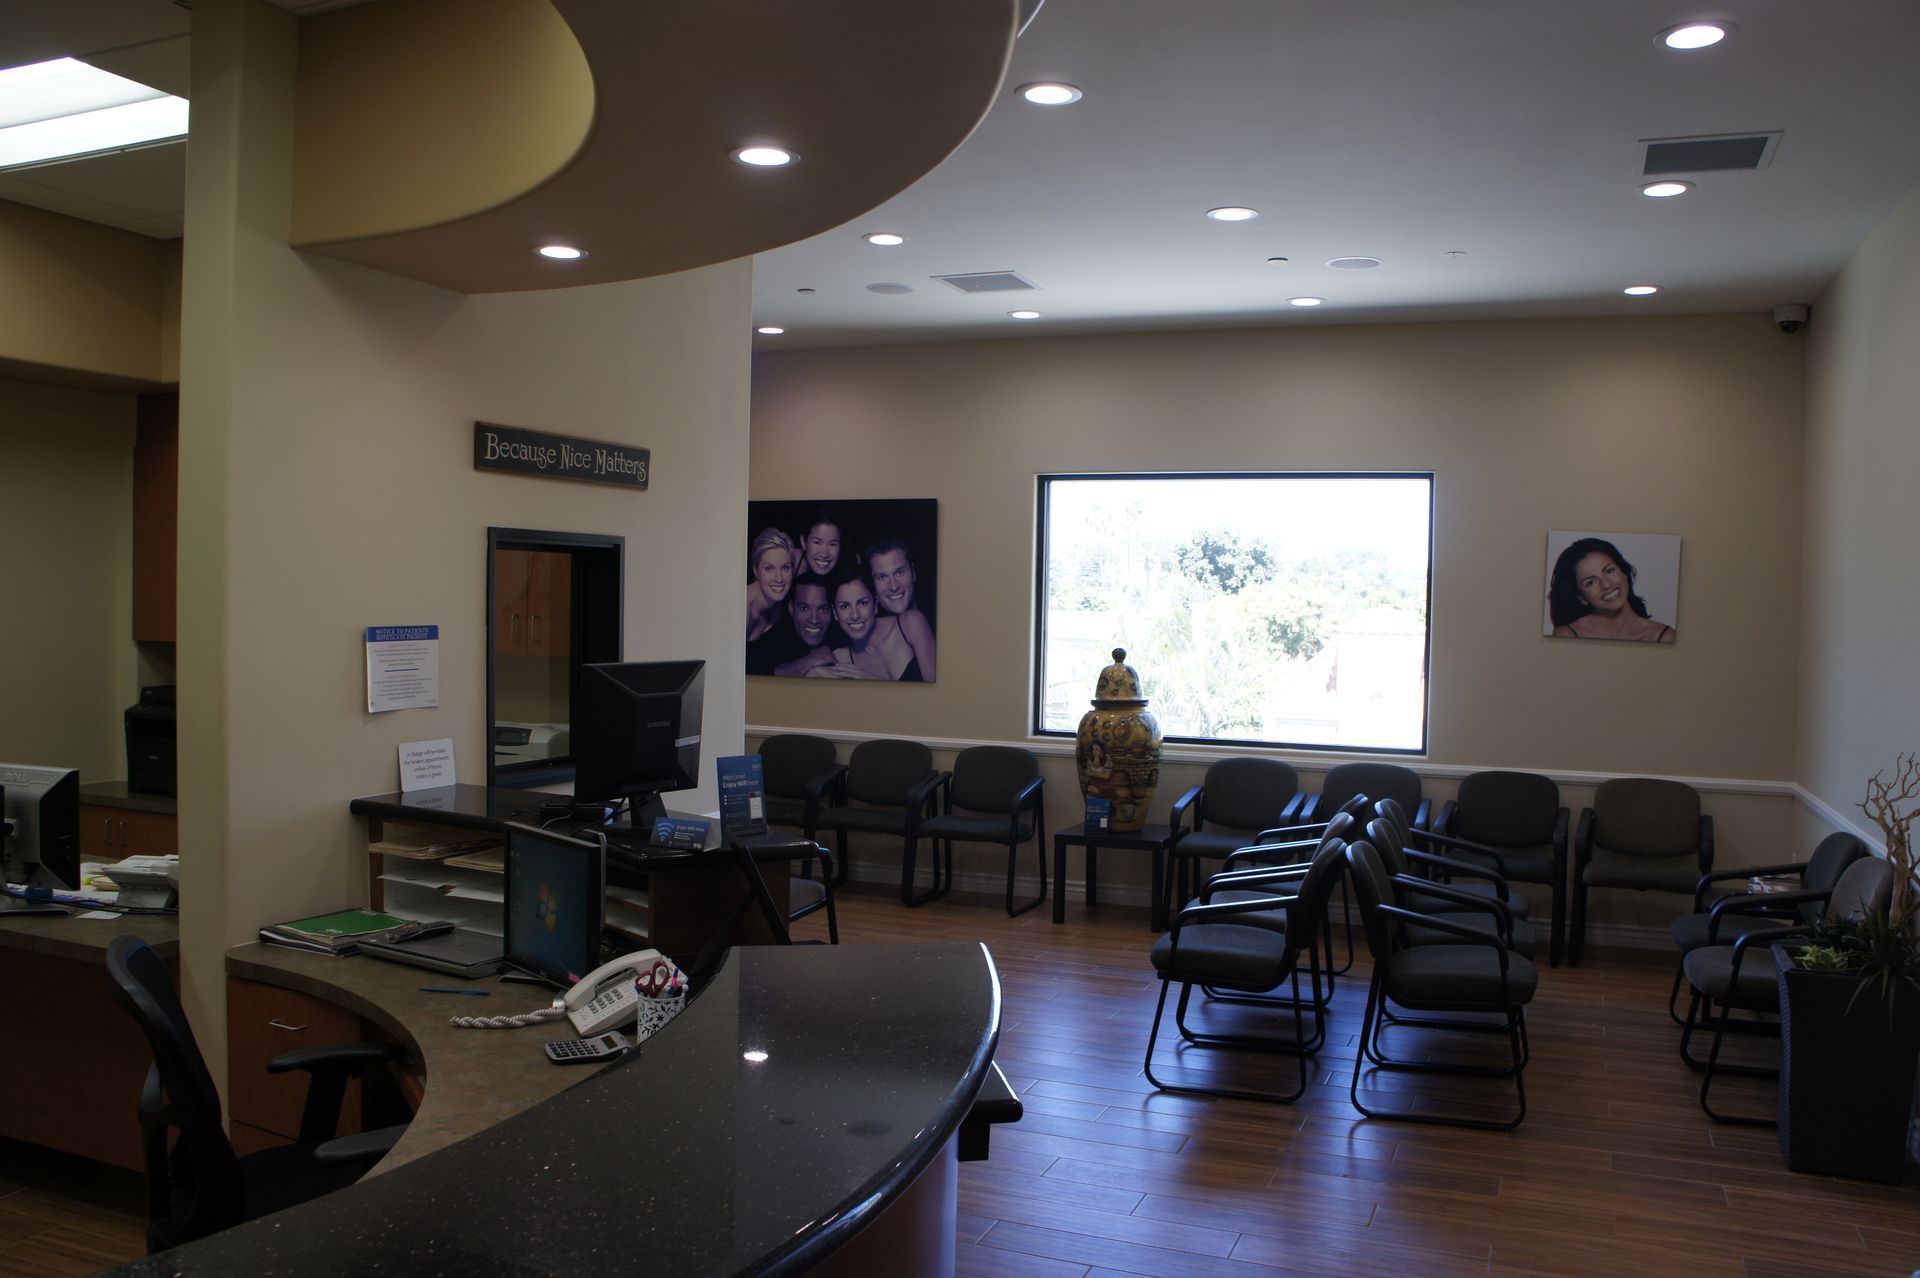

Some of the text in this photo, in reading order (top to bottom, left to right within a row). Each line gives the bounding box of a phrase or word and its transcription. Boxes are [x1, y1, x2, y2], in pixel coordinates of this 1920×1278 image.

[484, 433, 647, 482] Because Nice Matters
